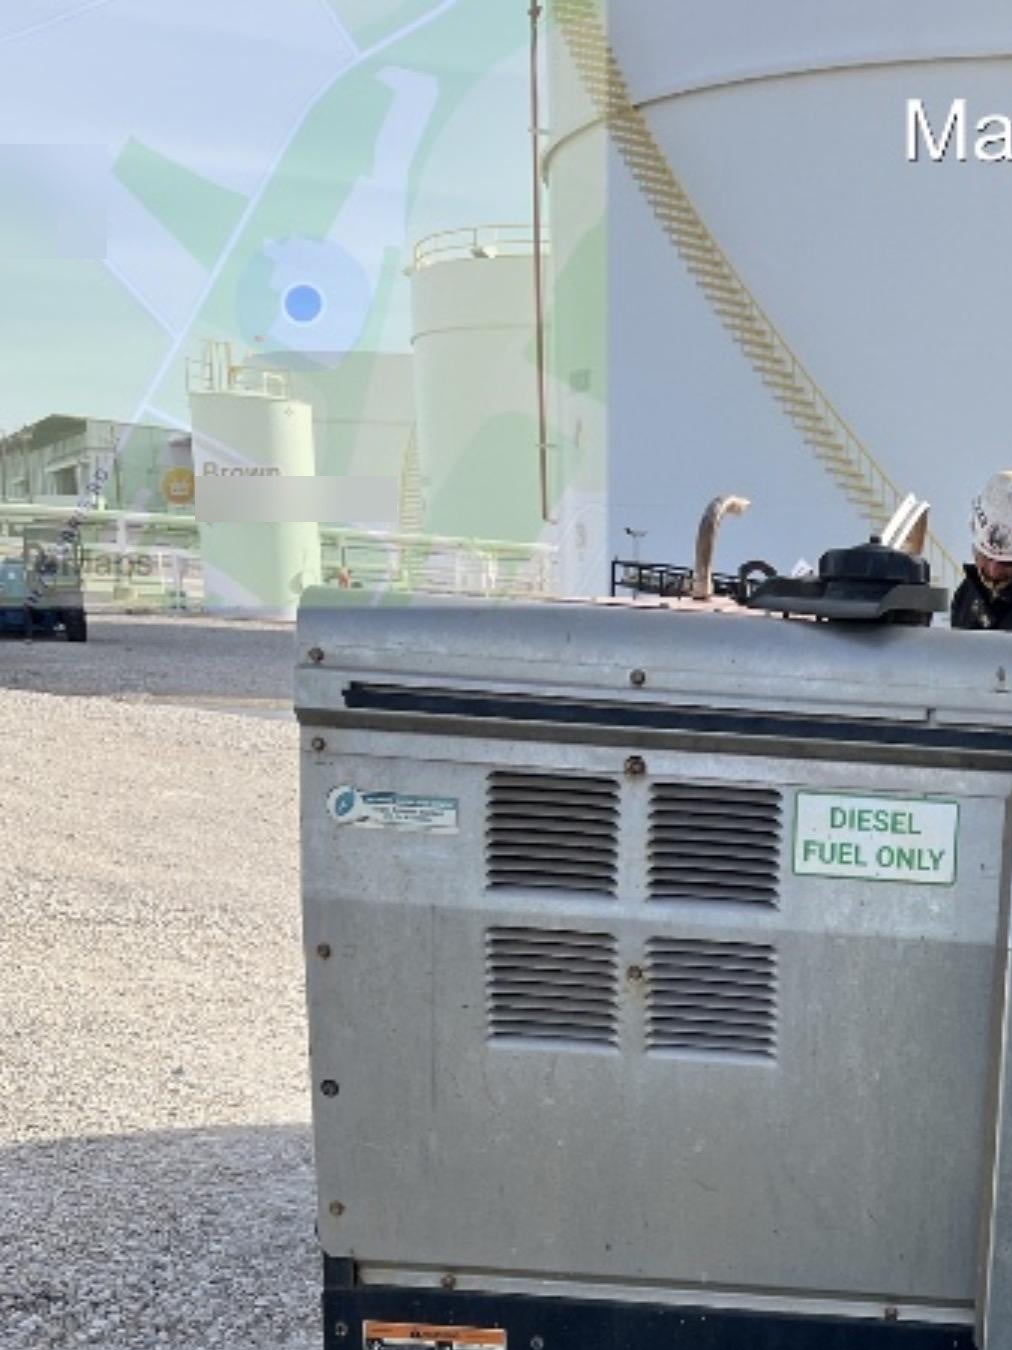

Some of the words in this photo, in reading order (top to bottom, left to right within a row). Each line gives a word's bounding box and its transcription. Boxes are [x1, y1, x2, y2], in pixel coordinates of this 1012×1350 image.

[830, 806, 922, 835] DIESEL
[803, 839, 867, 868] FUEL
[876, 845, 945, 871] ONLY
